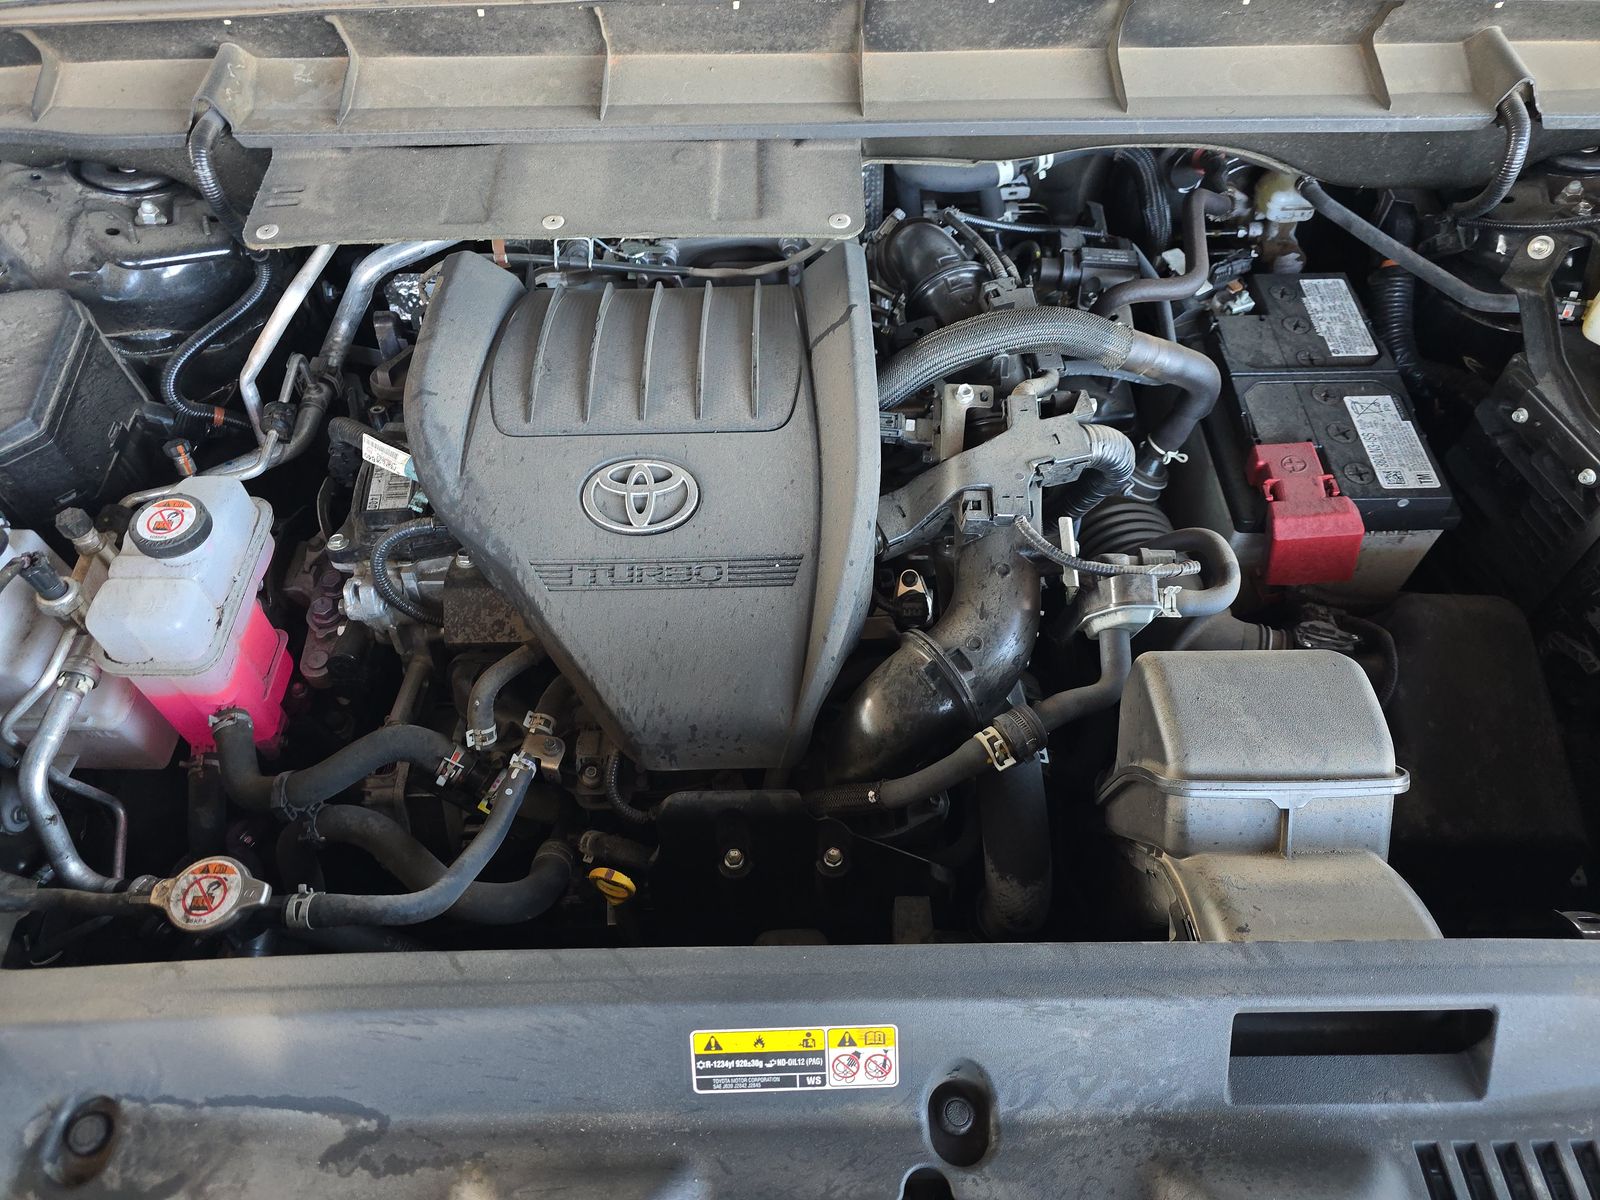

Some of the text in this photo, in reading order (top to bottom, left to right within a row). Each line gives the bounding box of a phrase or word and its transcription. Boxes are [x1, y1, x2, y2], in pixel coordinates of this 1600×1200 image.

[577, 563, 724, 585] TURBO
[705, 1060, 735, 1069] R-1234yf
[805, 1057, 823, 1066] (PAG)
[806, 1076, 822, 1085] WS
